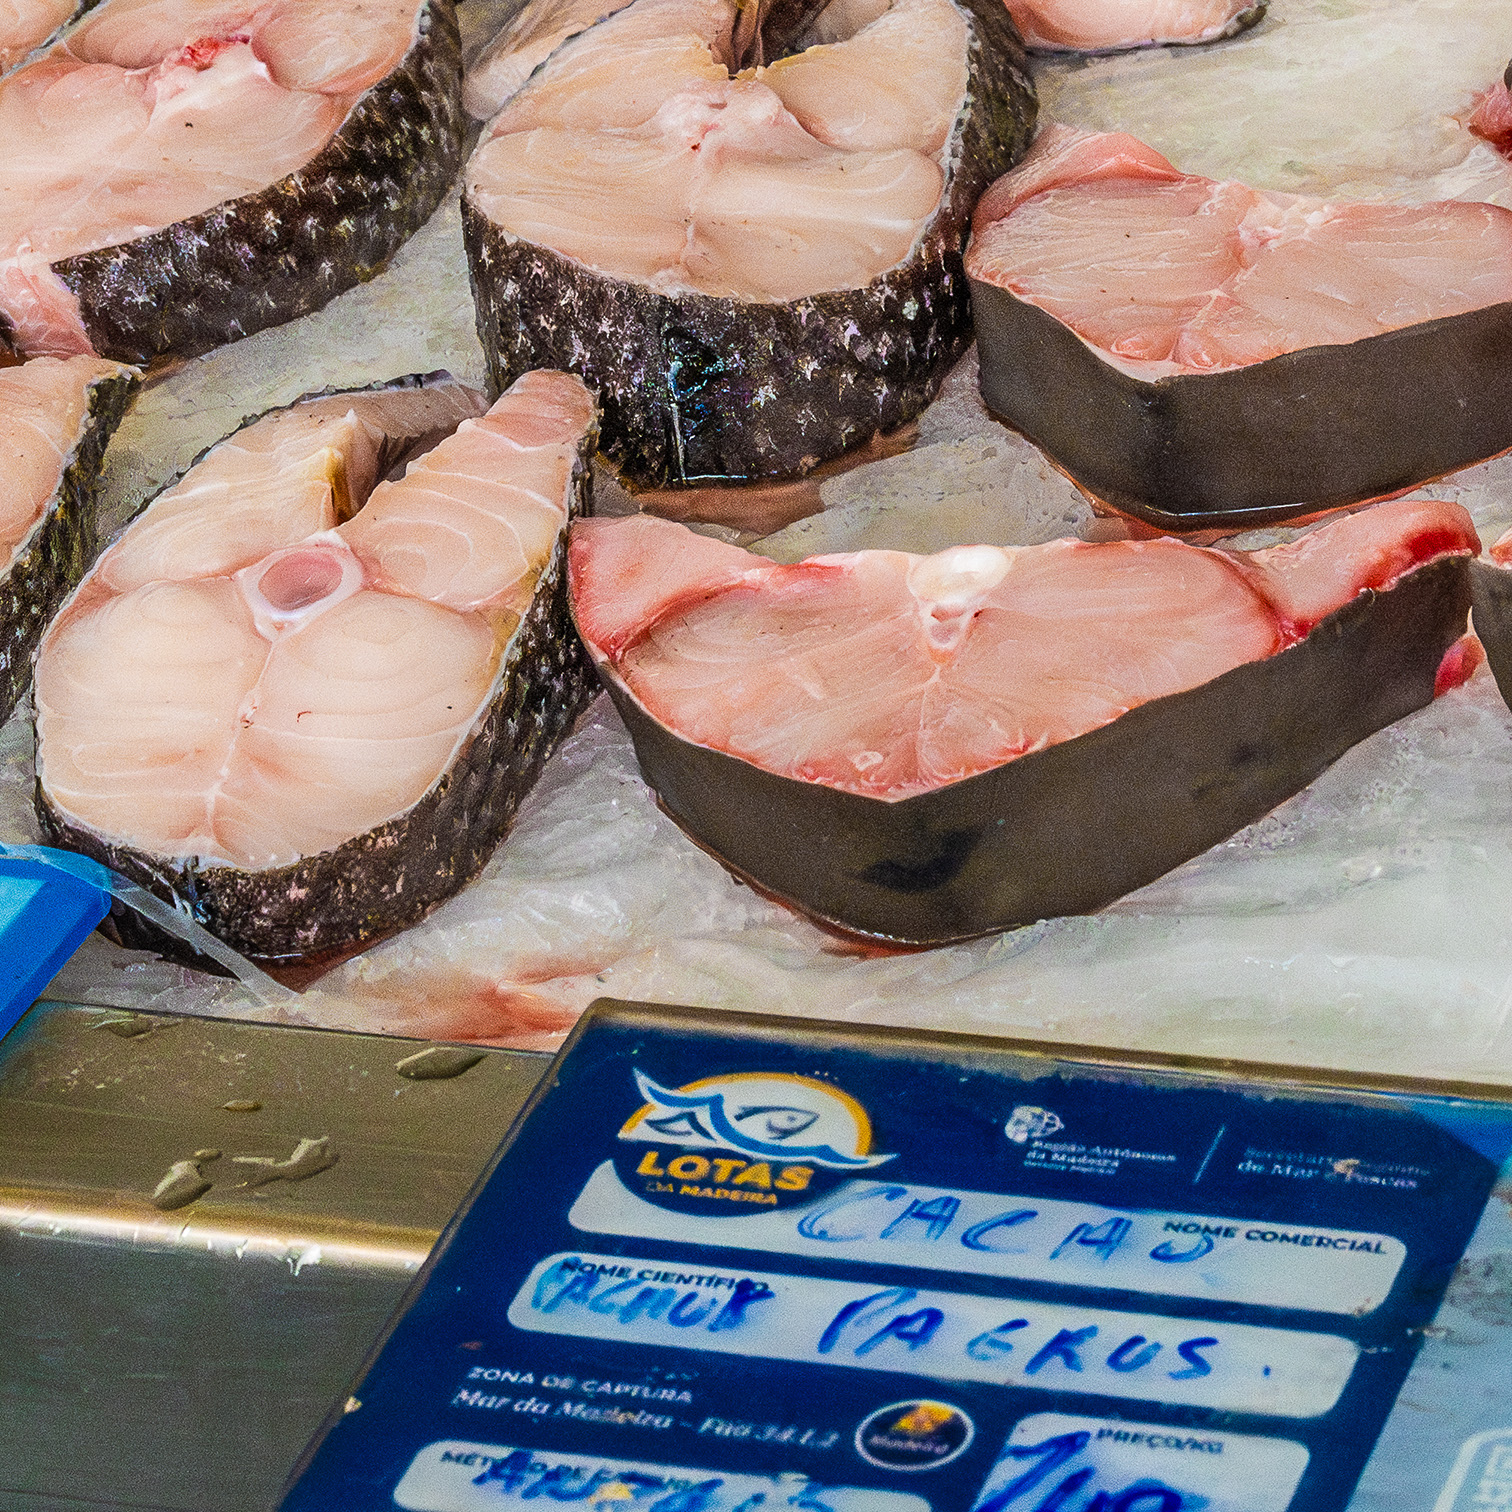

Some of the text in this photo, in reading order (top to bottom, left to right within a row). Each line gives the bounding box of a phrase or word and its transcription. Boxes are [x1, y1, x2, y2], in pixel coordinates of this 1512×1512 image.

[637, 1151, 815, 1191] LOTAS
[679, 1185, 778, 1205] MADEIRA
[1164, 1219, 1388, 1255] NOME COMERCIAL
[559, 1261, 630, 1280] NOME
[467, 1366, 693, 1404] ZONA DE CAPTURA
[452, 1388, 511, 1412] Mar
[513, 1395, 551, 1416] da
